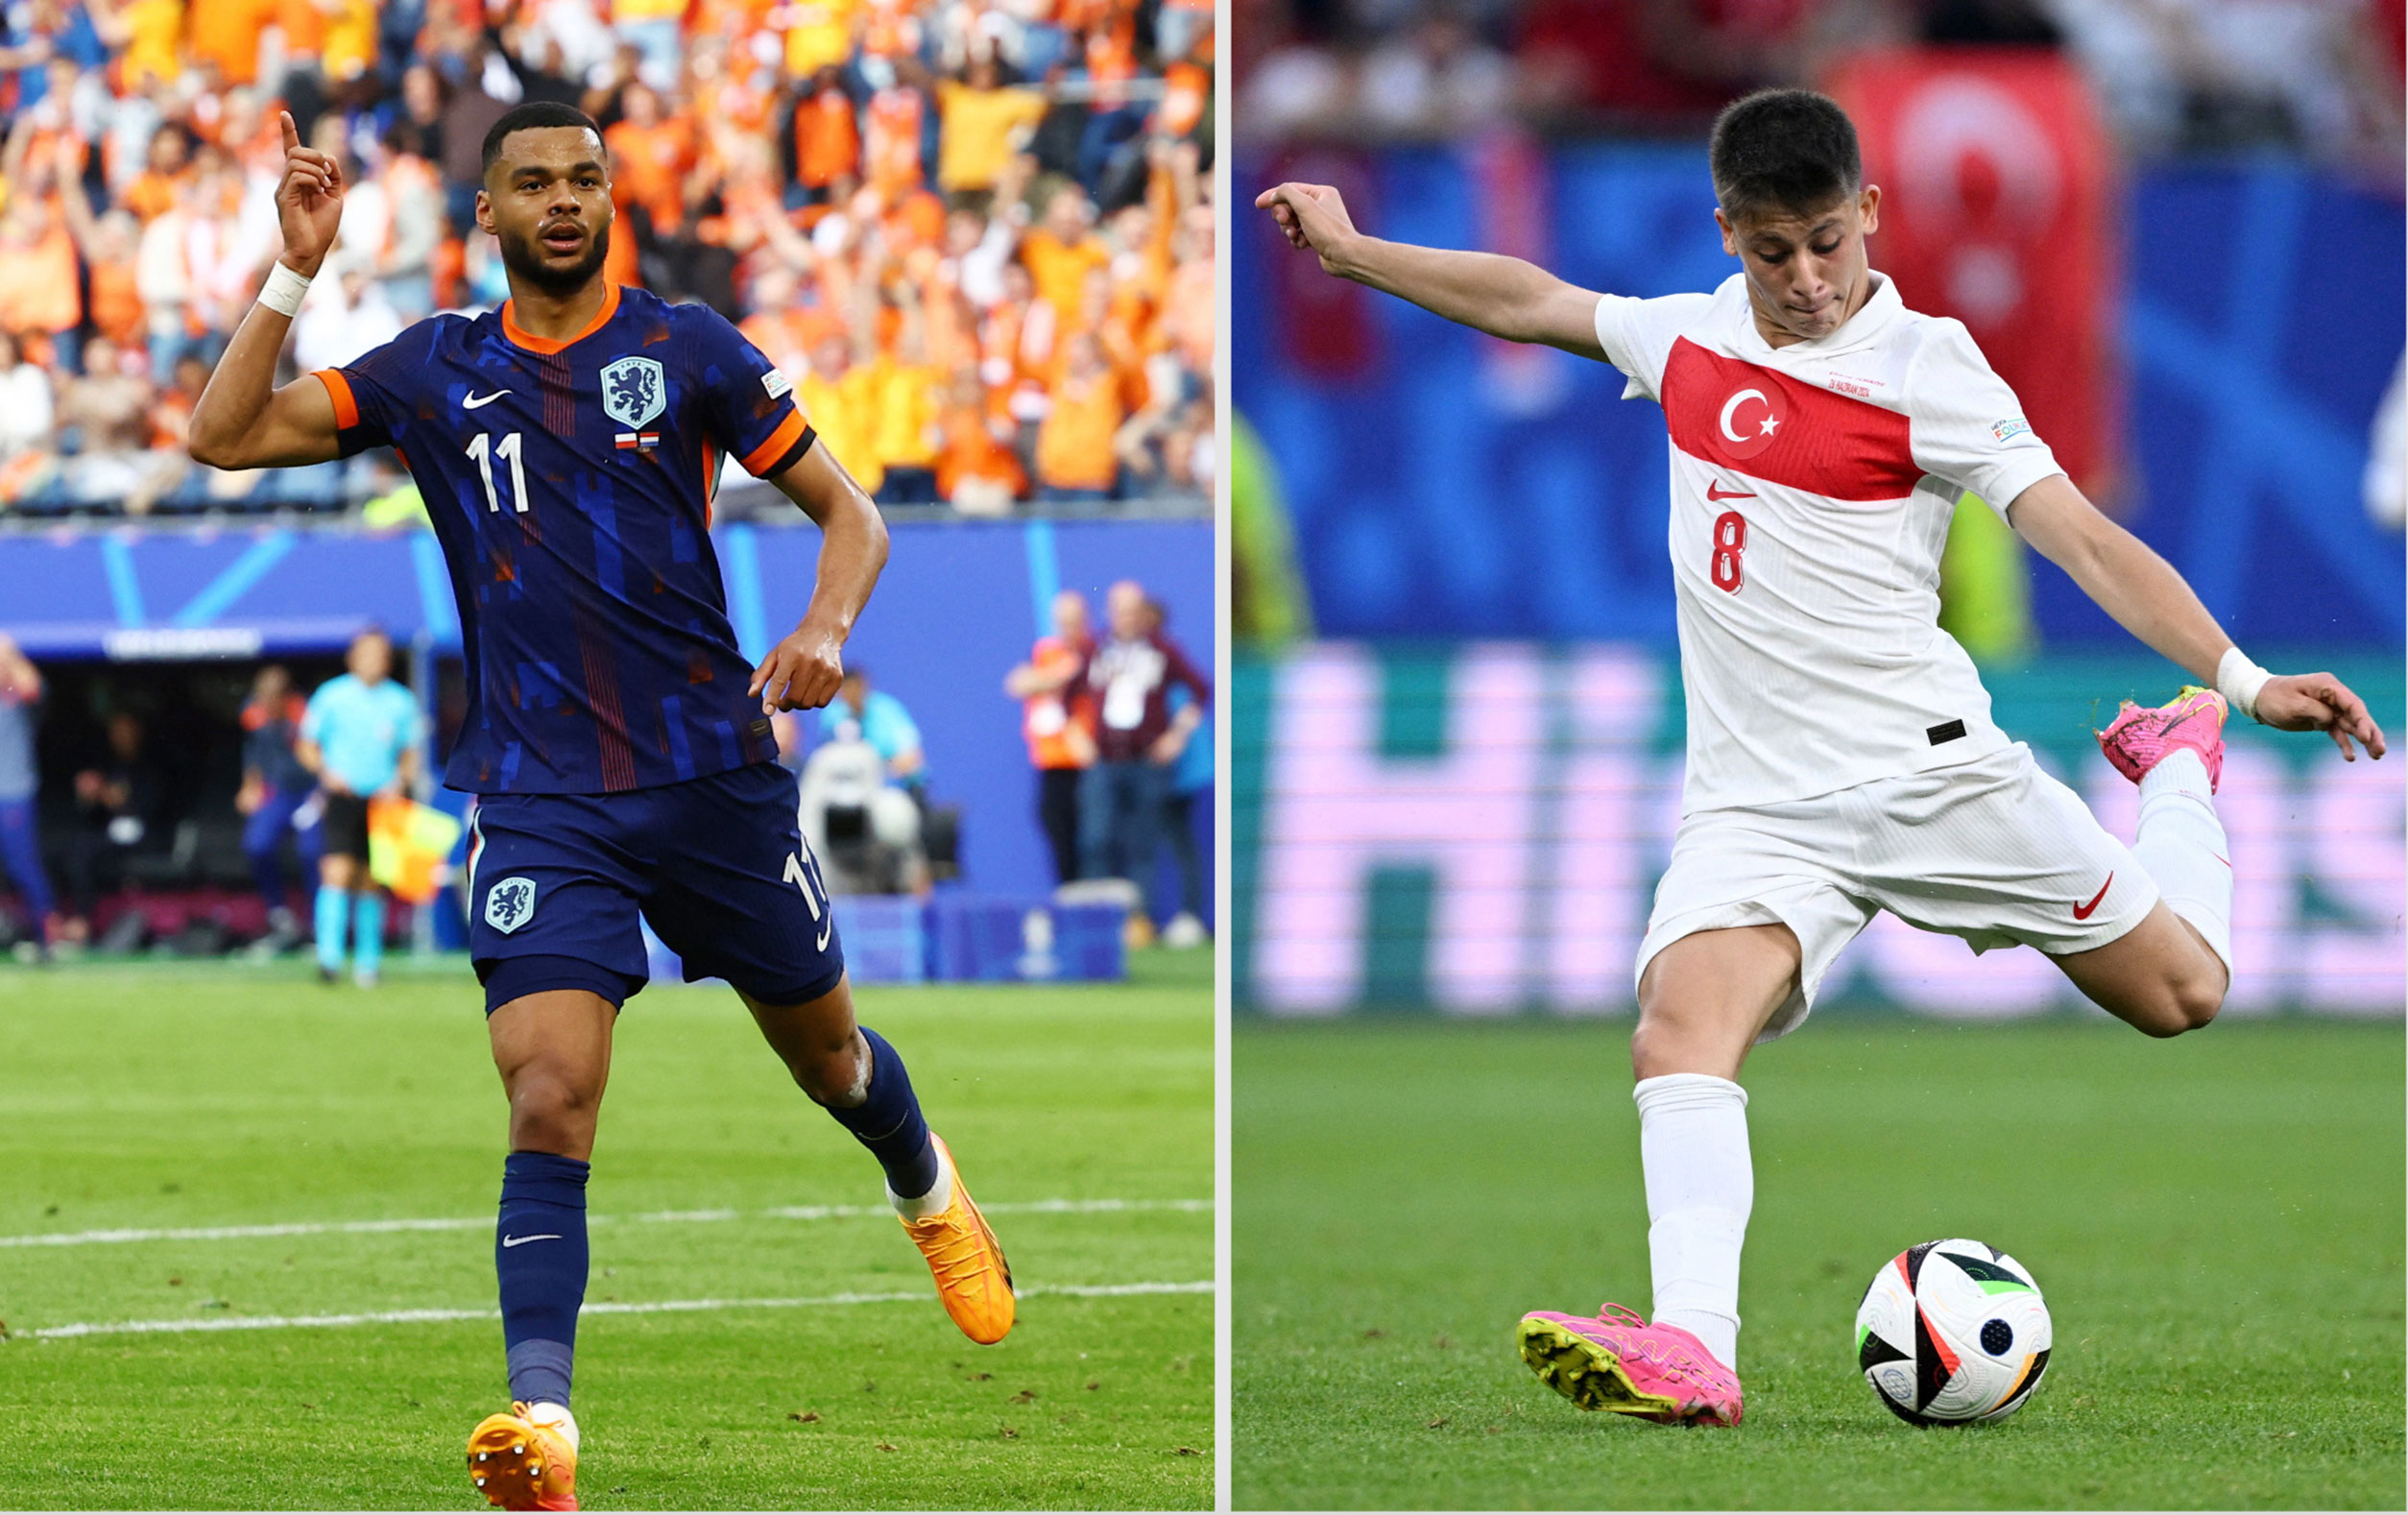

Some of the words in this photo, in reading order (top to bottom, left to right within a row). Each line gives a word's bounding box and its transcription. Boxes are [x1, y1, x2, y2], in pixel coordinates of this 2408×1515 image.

[466, 432, 529, 513] 11
[1711, 511, 1747, 596] 8
[783, 833, 827, 922] 11
